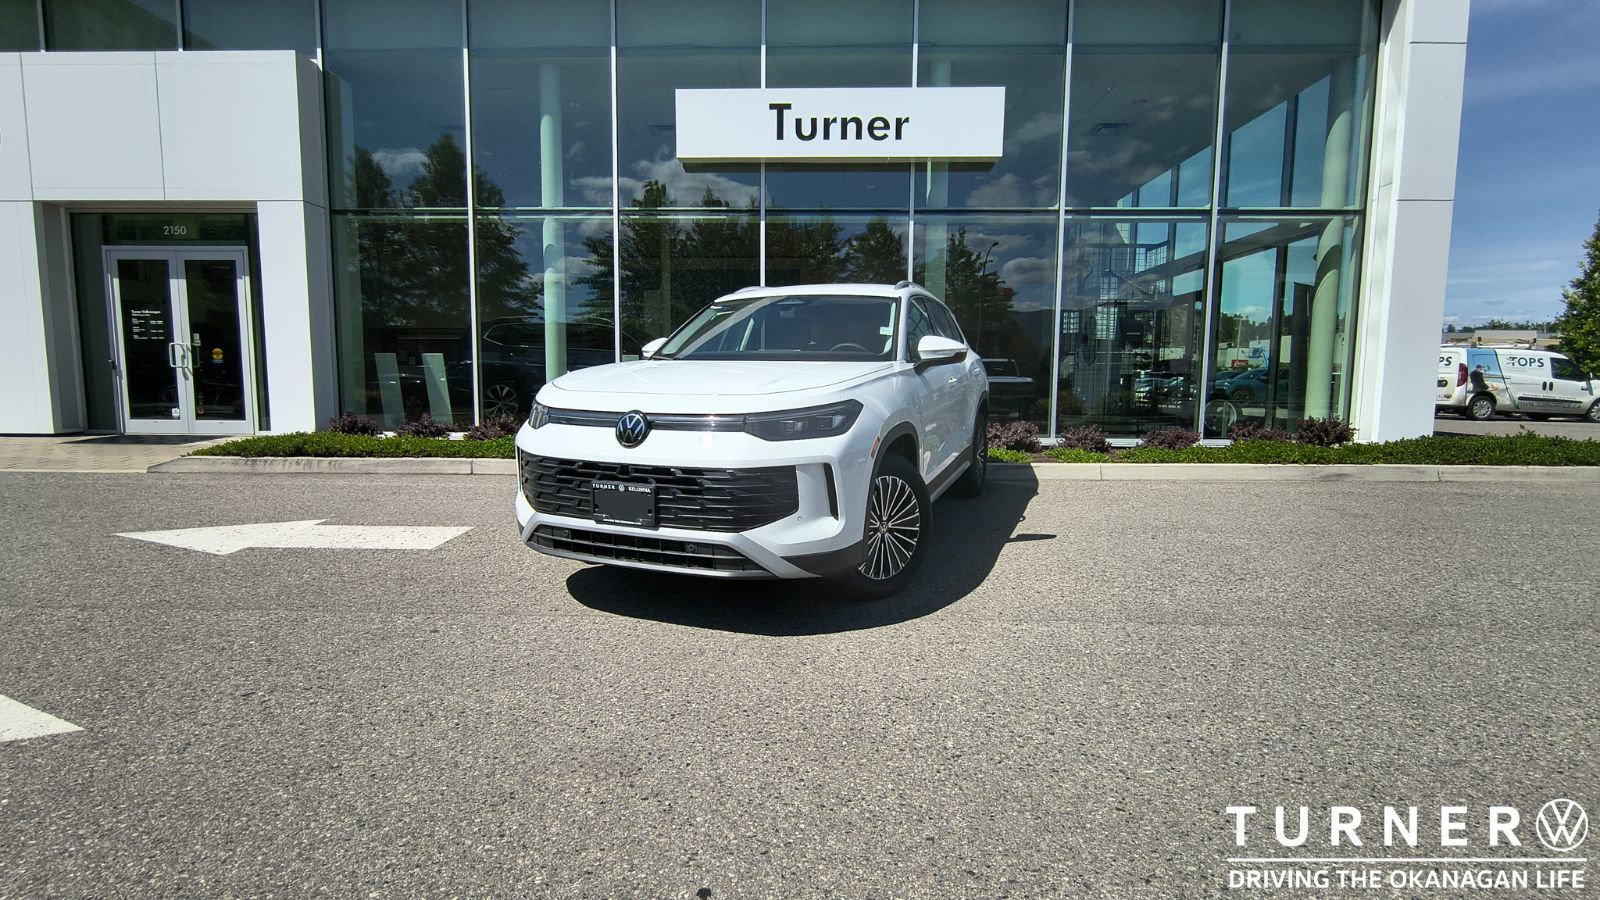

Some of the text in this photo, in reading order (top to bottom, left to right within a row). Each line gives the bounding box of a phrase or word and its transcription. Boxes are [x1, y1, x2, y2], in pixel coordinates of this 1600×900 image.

[769, 103, 910, 141] Turner
[163, 225, 187, 235] 2150
[1507, 356, 1545, 368] TOPS
